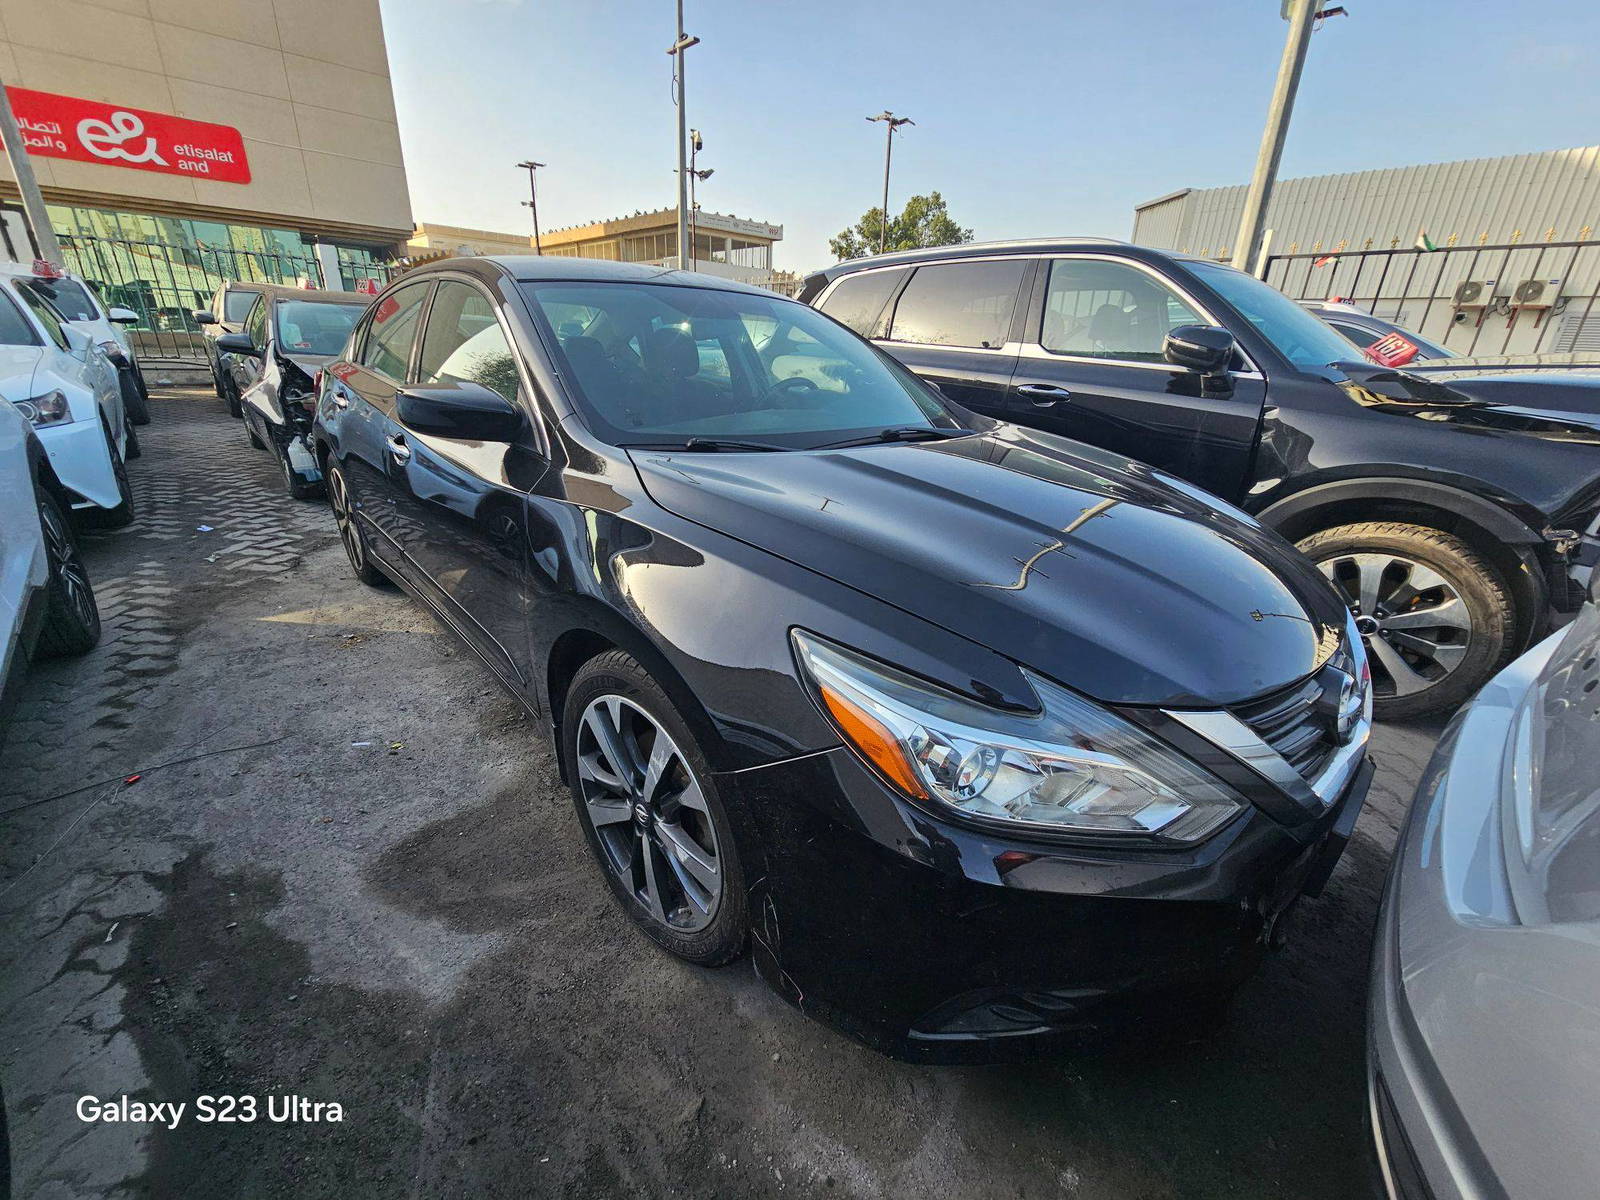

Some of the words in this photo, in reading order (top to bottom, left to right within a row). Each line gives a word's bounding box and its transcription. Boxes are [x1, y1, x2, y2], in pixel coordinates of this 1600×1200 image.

[23, 132, 54, 148] المز
[173, 144, 234, 163] etisalat
[178, 159, 209, 173] and
[1374, 337, 1410, 359] 167
